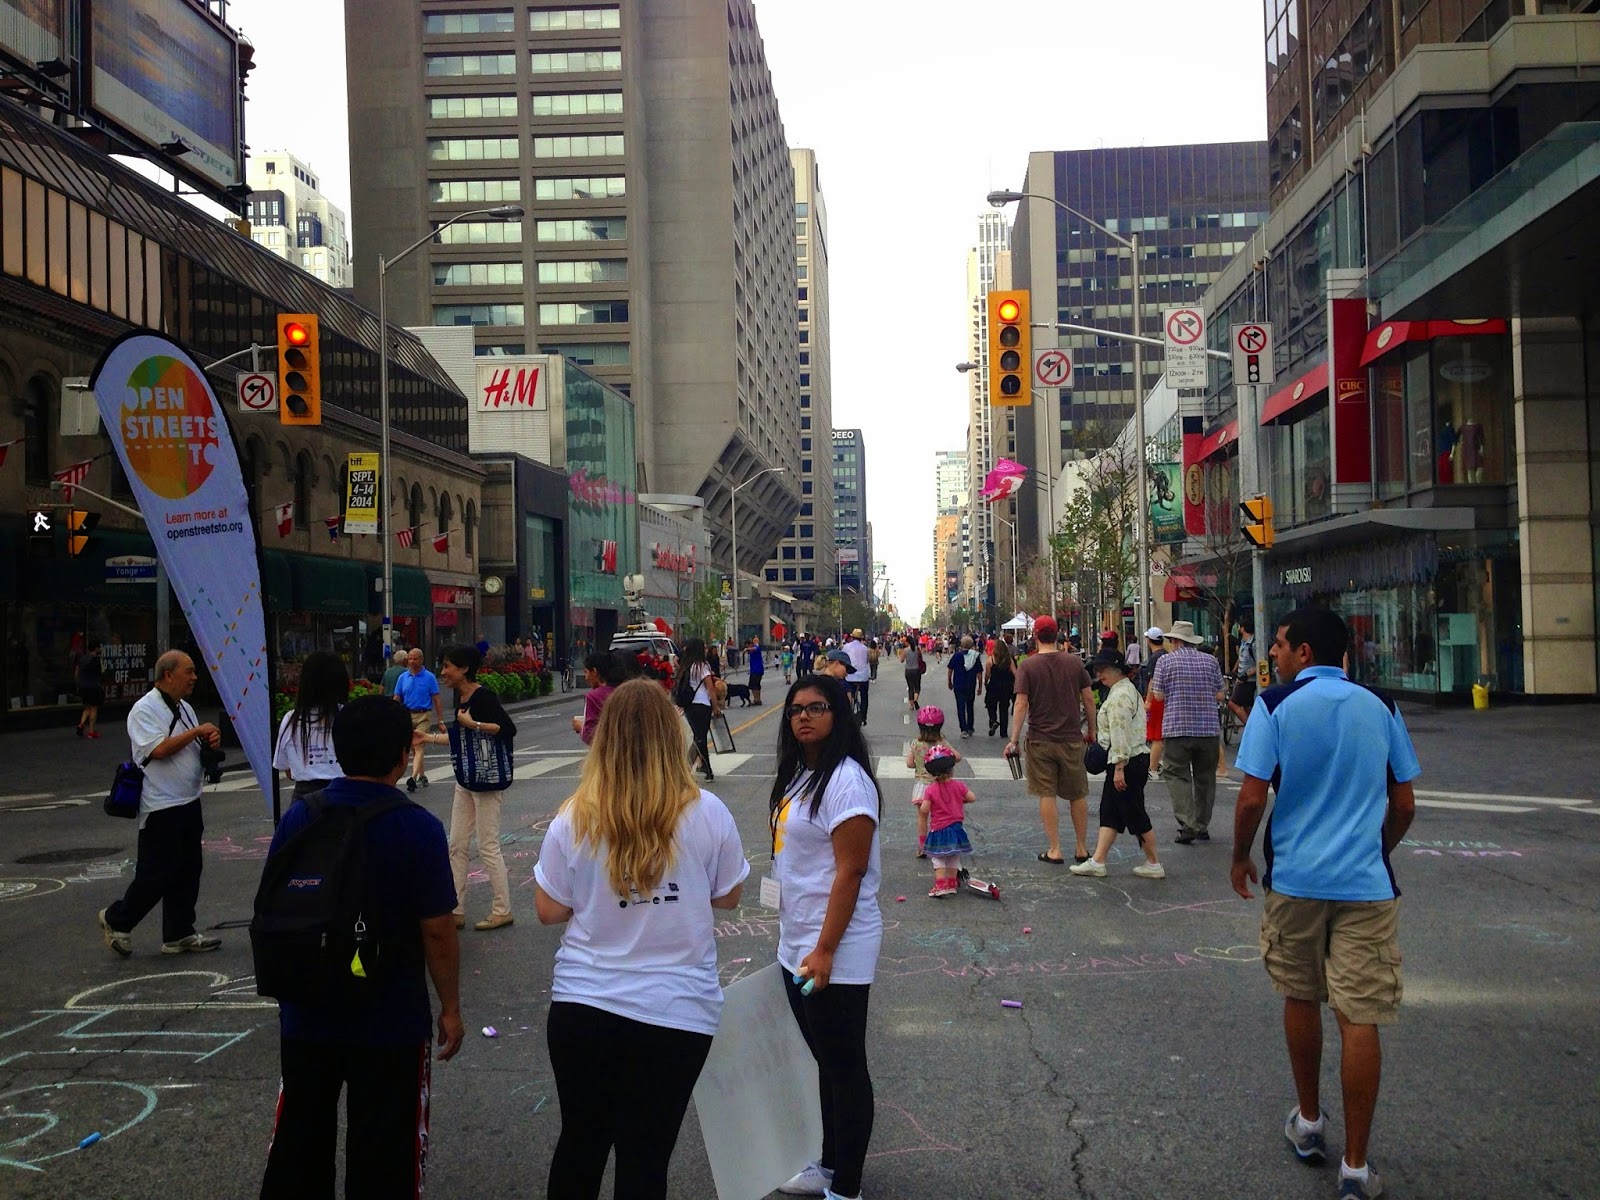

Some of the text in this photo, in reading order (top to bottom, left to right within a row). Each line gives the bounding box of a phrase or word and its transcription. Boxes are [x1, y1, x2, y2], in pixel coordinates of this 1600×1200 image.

[484, 368, 539, 408] H&M
[1340, 381, 1364, 390] CIBC
[124, 386, 185, 412] OPEN
[126, 415, 219, 440] STREETS
[352, 471, 374, 483] SEPT.
[350, 496, 373, 507] 2014
[165, 507, 228, 524] Learn more at
[166, 521, 243, 541] openstreetsto.org
[115, 567, 139, 577] Yonge
[100, 643, 147, 657] NTIRE STORE
[115, 670, 129, 683] OFF
